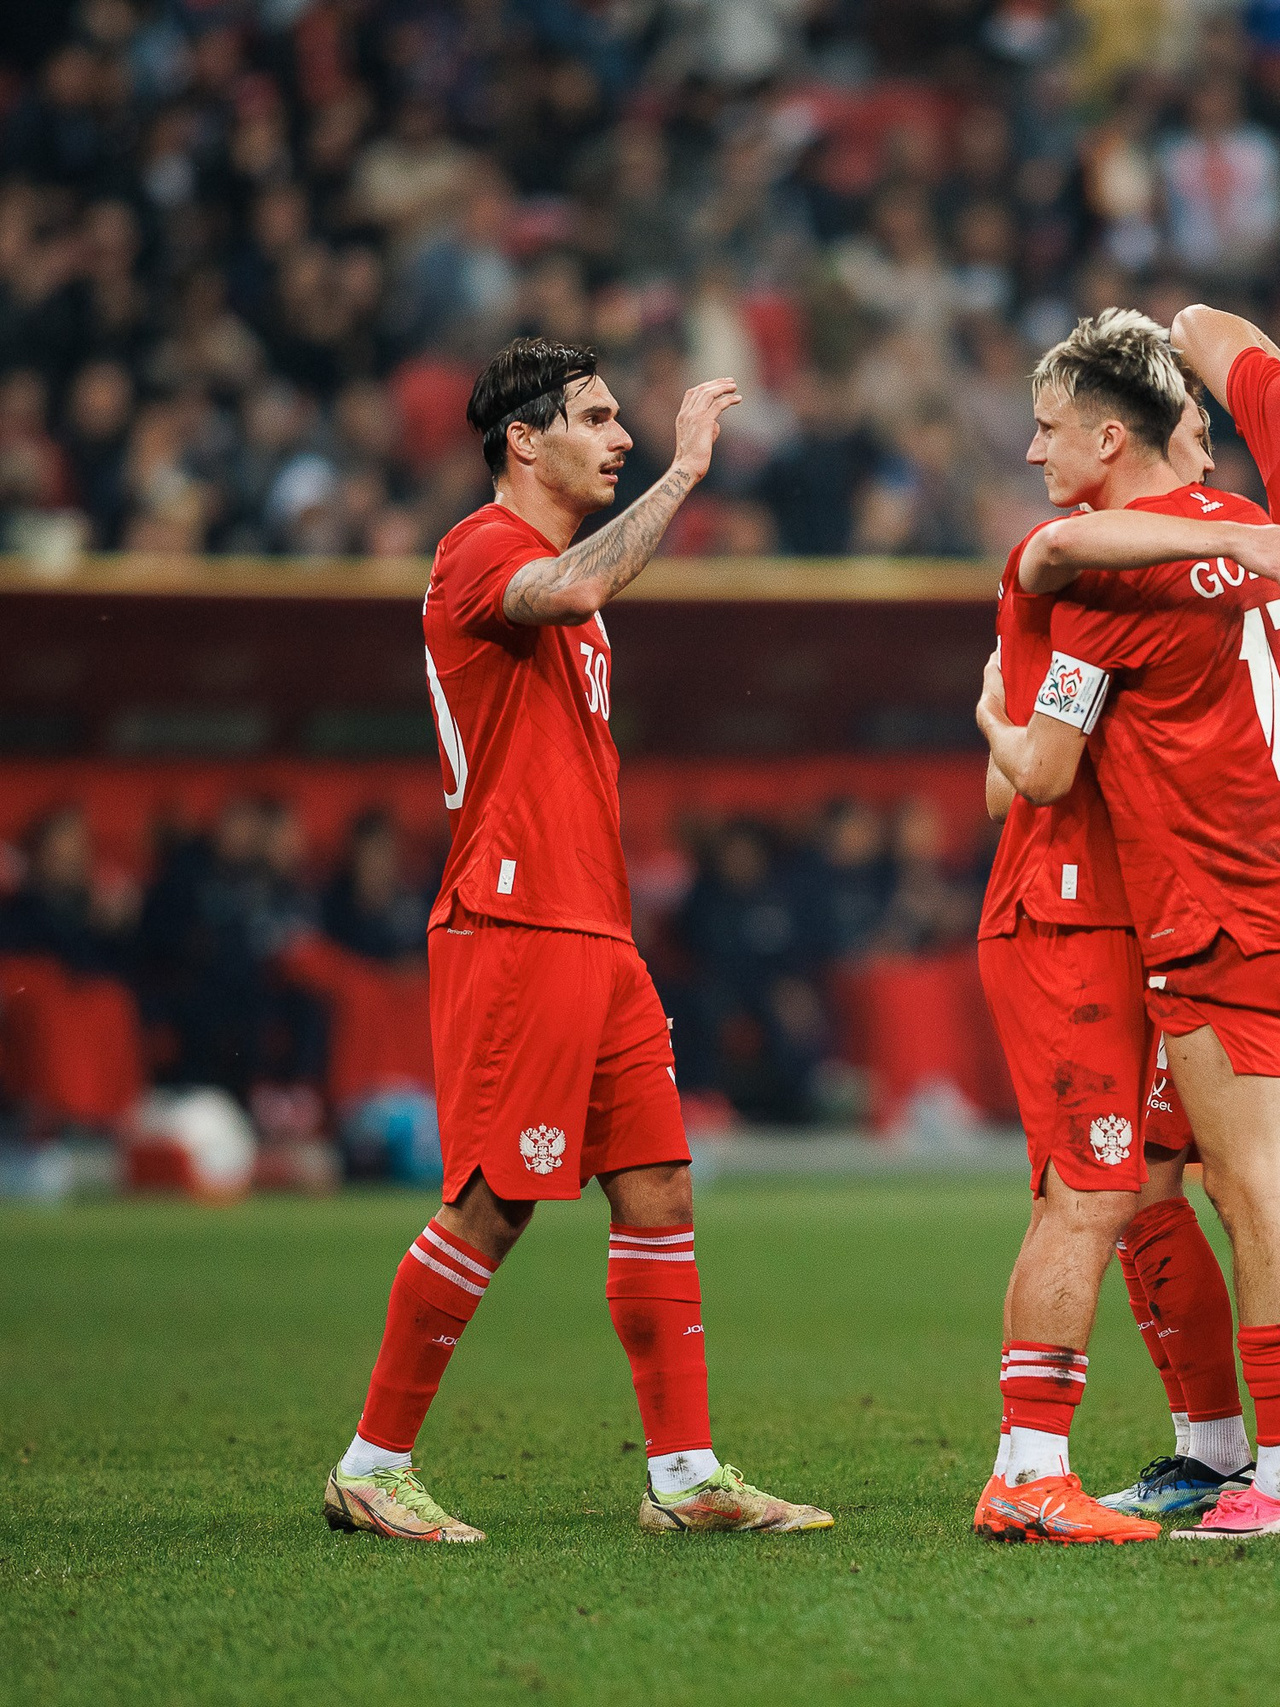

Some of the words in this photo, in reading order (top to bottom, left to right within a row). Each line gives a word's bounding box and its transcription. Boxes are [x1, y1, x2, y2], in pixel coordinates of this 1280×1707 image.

[1190, 557, 1259, 599] GO
[580, 641, 610, 722] 30
[1150, 1099, 1173, 1113] GEL
[682, 1324, 705, 1336] JO
